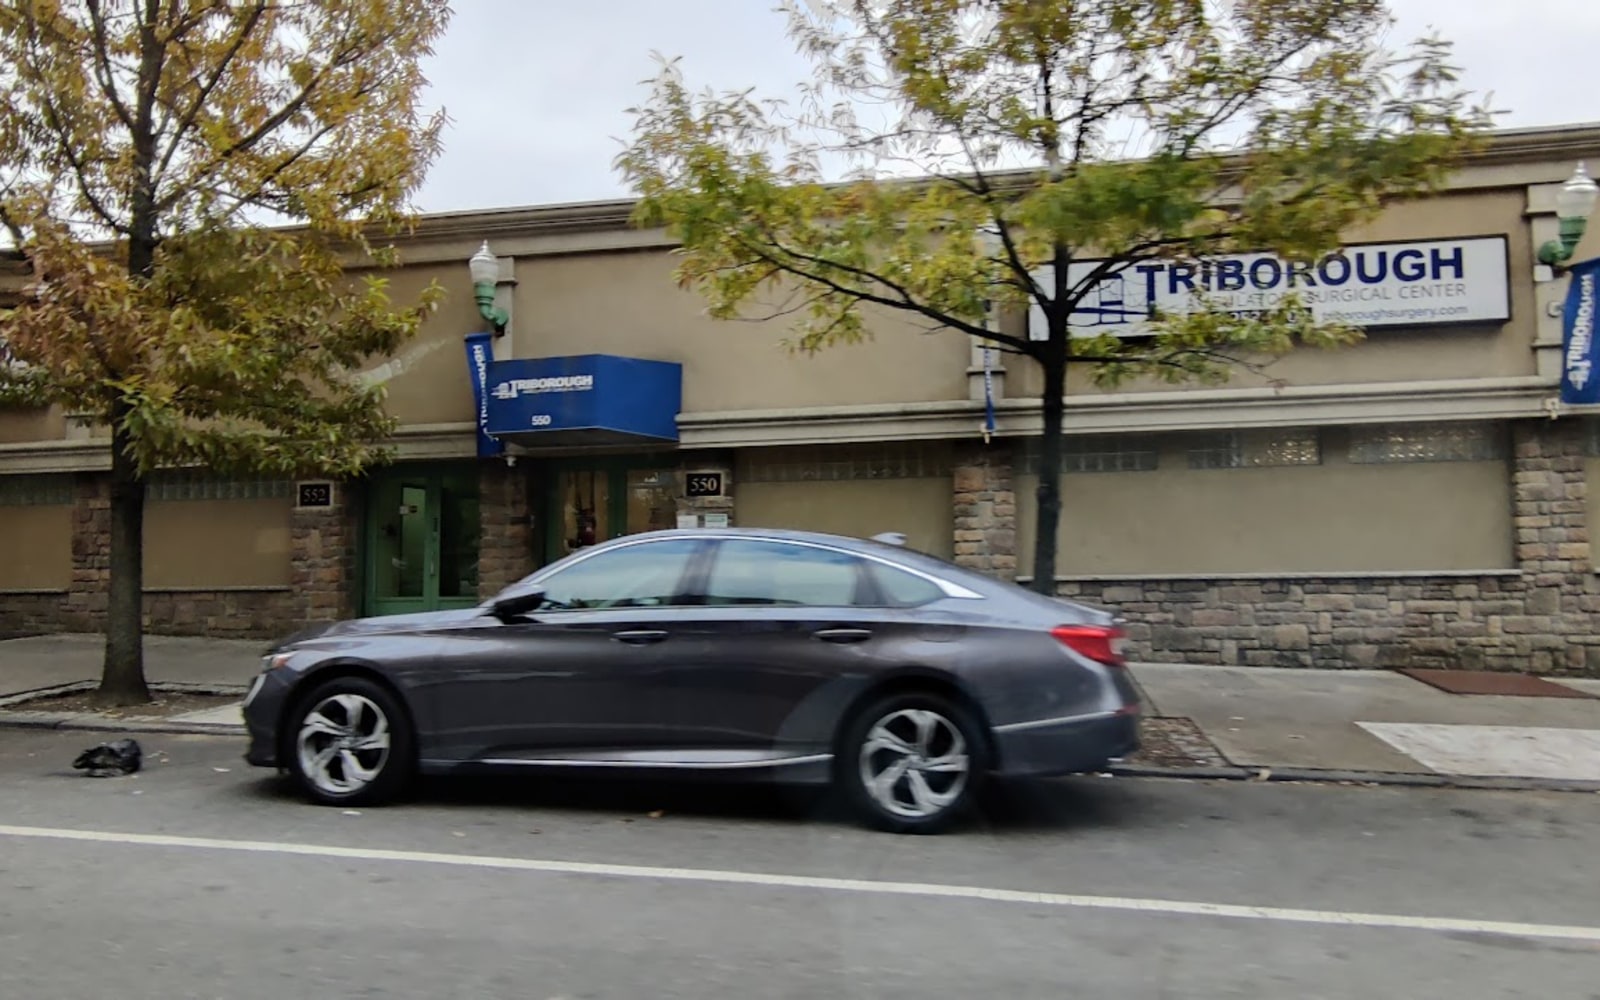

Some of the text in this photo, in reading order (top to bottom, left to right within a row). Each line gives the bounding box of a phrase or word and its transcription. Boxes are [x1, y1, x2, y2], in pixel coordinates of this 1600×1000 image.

[1136, 247, 1464, 321] TRIBOROUGH
[1302, 287, 1391, 304] SURGICAL
[1398, 283, 1466, 299] CENTER
[1566, 274, 1594, 369] TRIBOROUGH
[509, 375, 593, 398] TRIBOROUGH
[531, 415, 551, 426] 550
[303, 488, 326, 502] 552
[690, 478, 718, 492] 550
